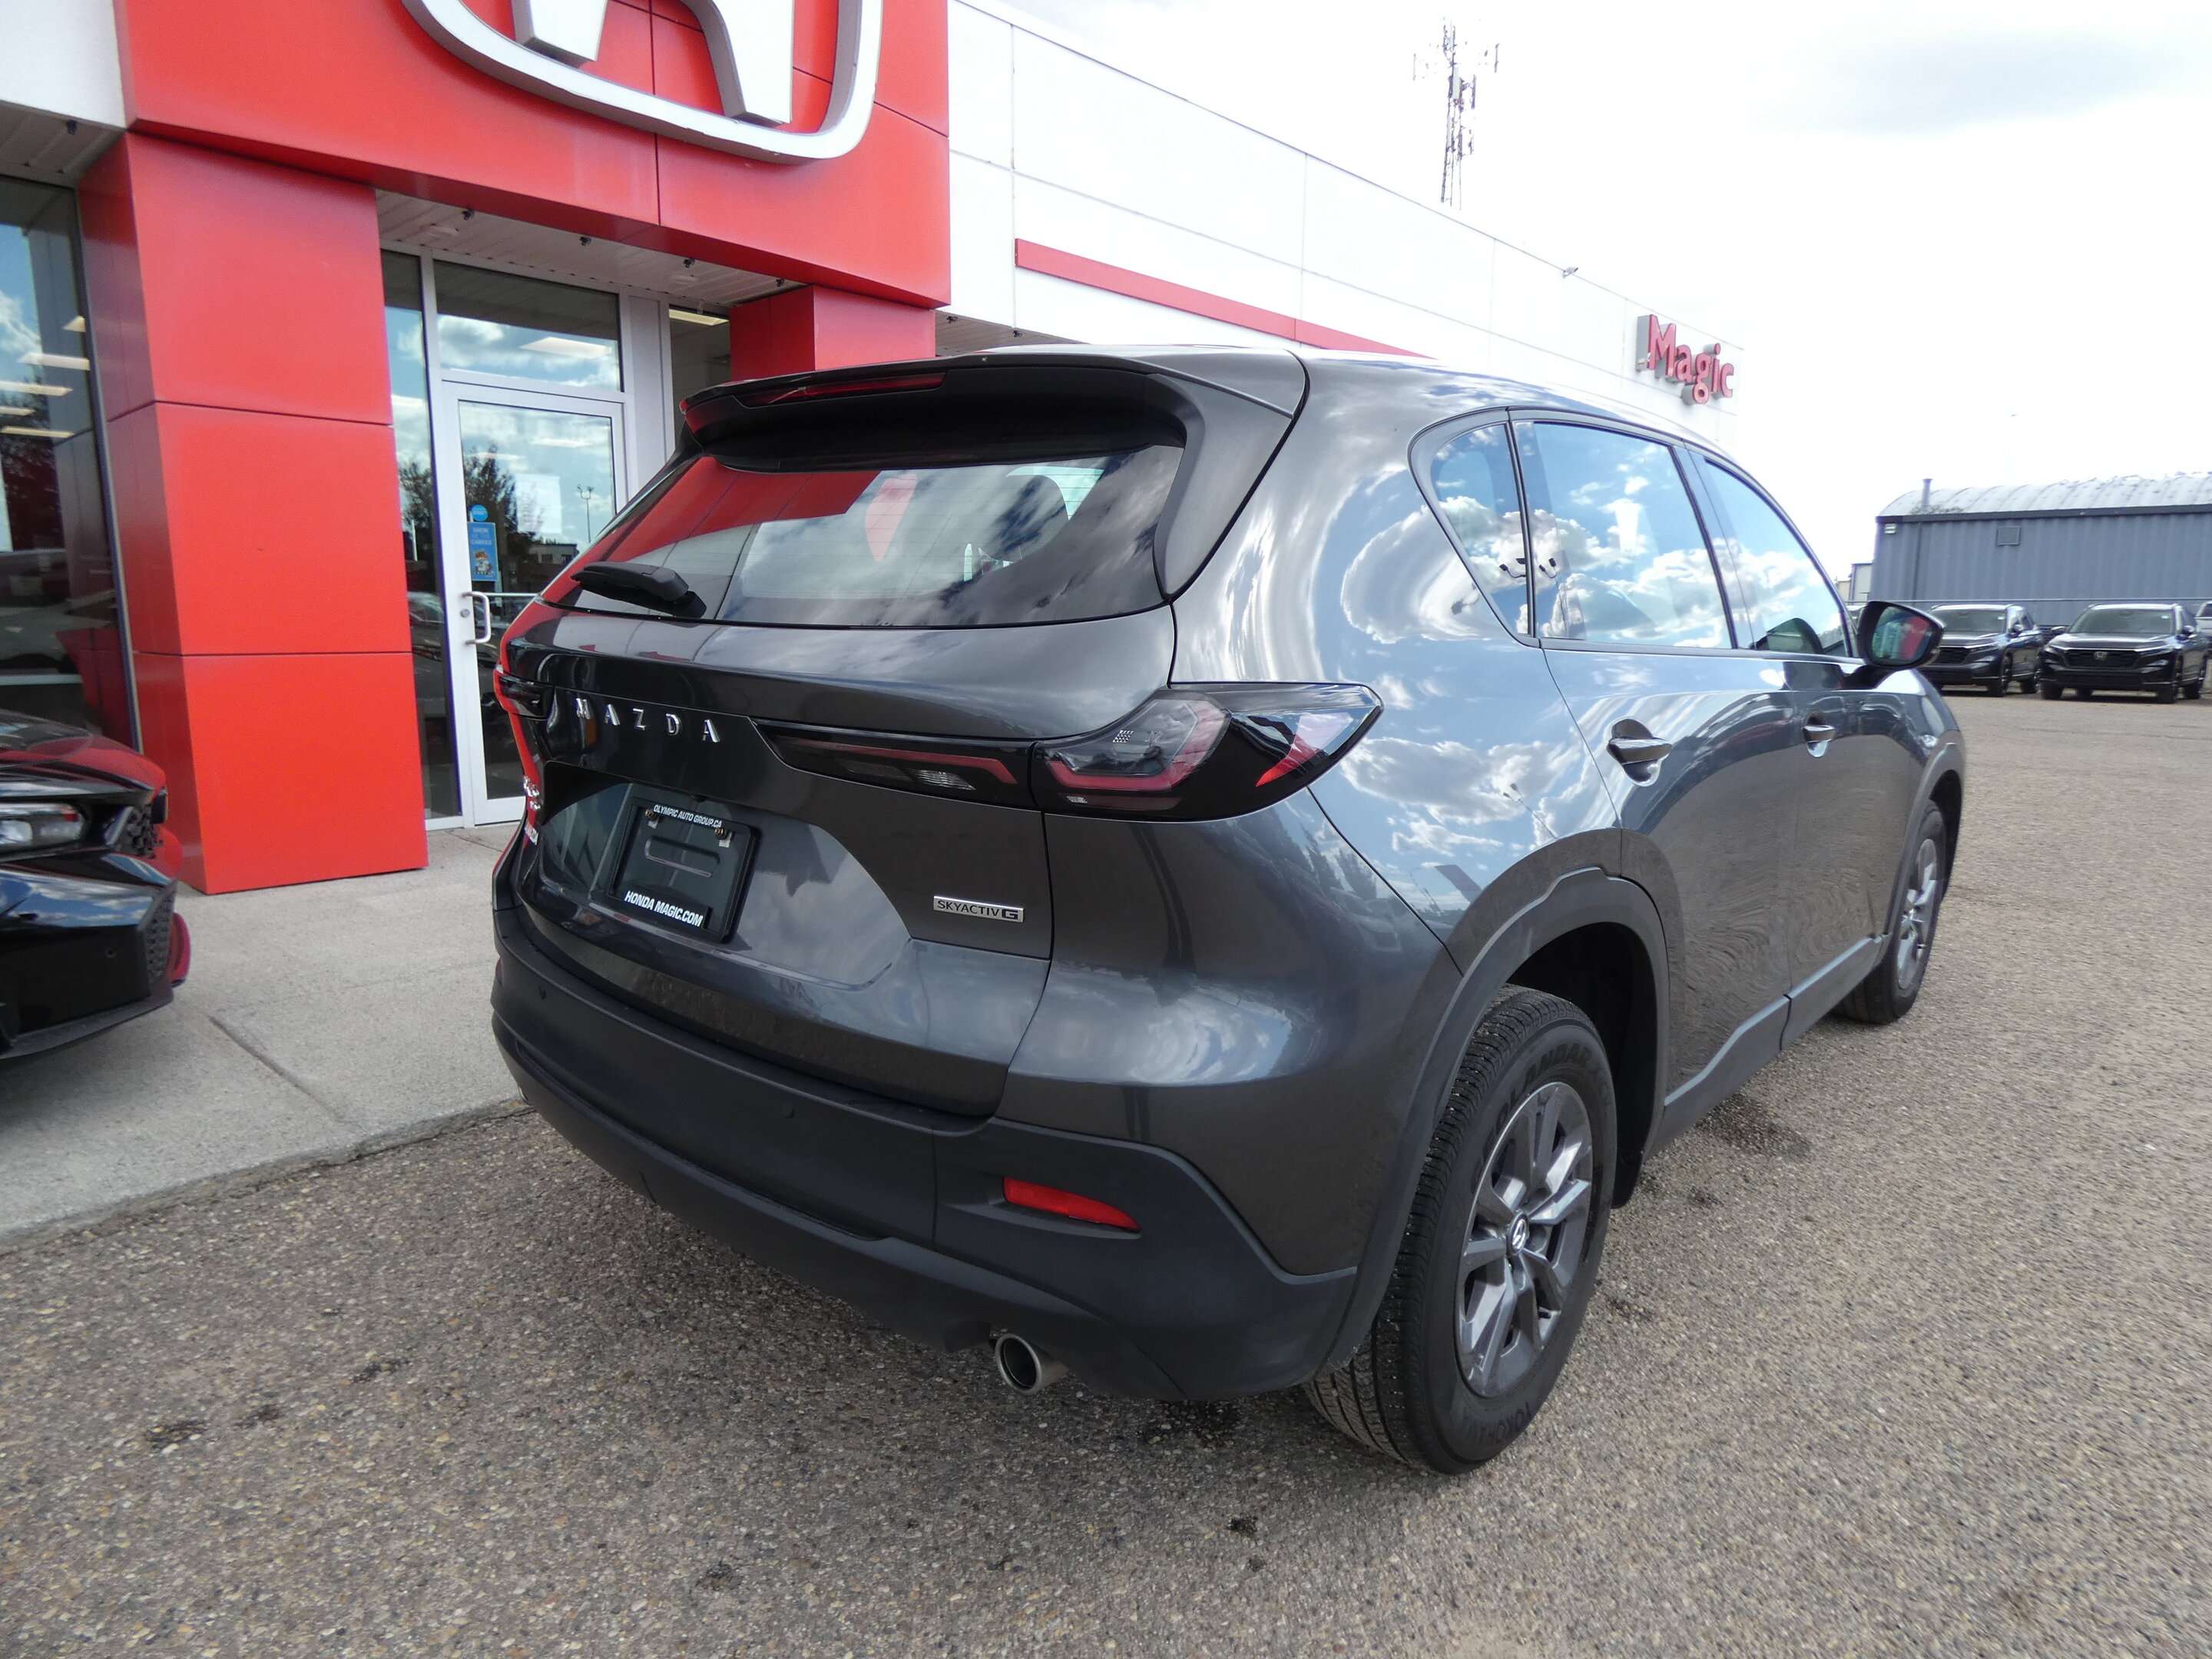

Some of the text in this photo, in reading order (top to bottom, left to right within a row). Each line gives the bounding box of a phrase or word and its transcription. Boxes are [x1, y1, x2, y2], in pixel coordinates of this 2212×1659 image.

[1646, 313, 1734, 405] Magic
[575, 697, 720, 743] MAZDA
[653, 804, 723, 828] OLYMPIC AUTO GROUP.CA
[624, 890, 704, 927] HONDA MAGIC.COM
